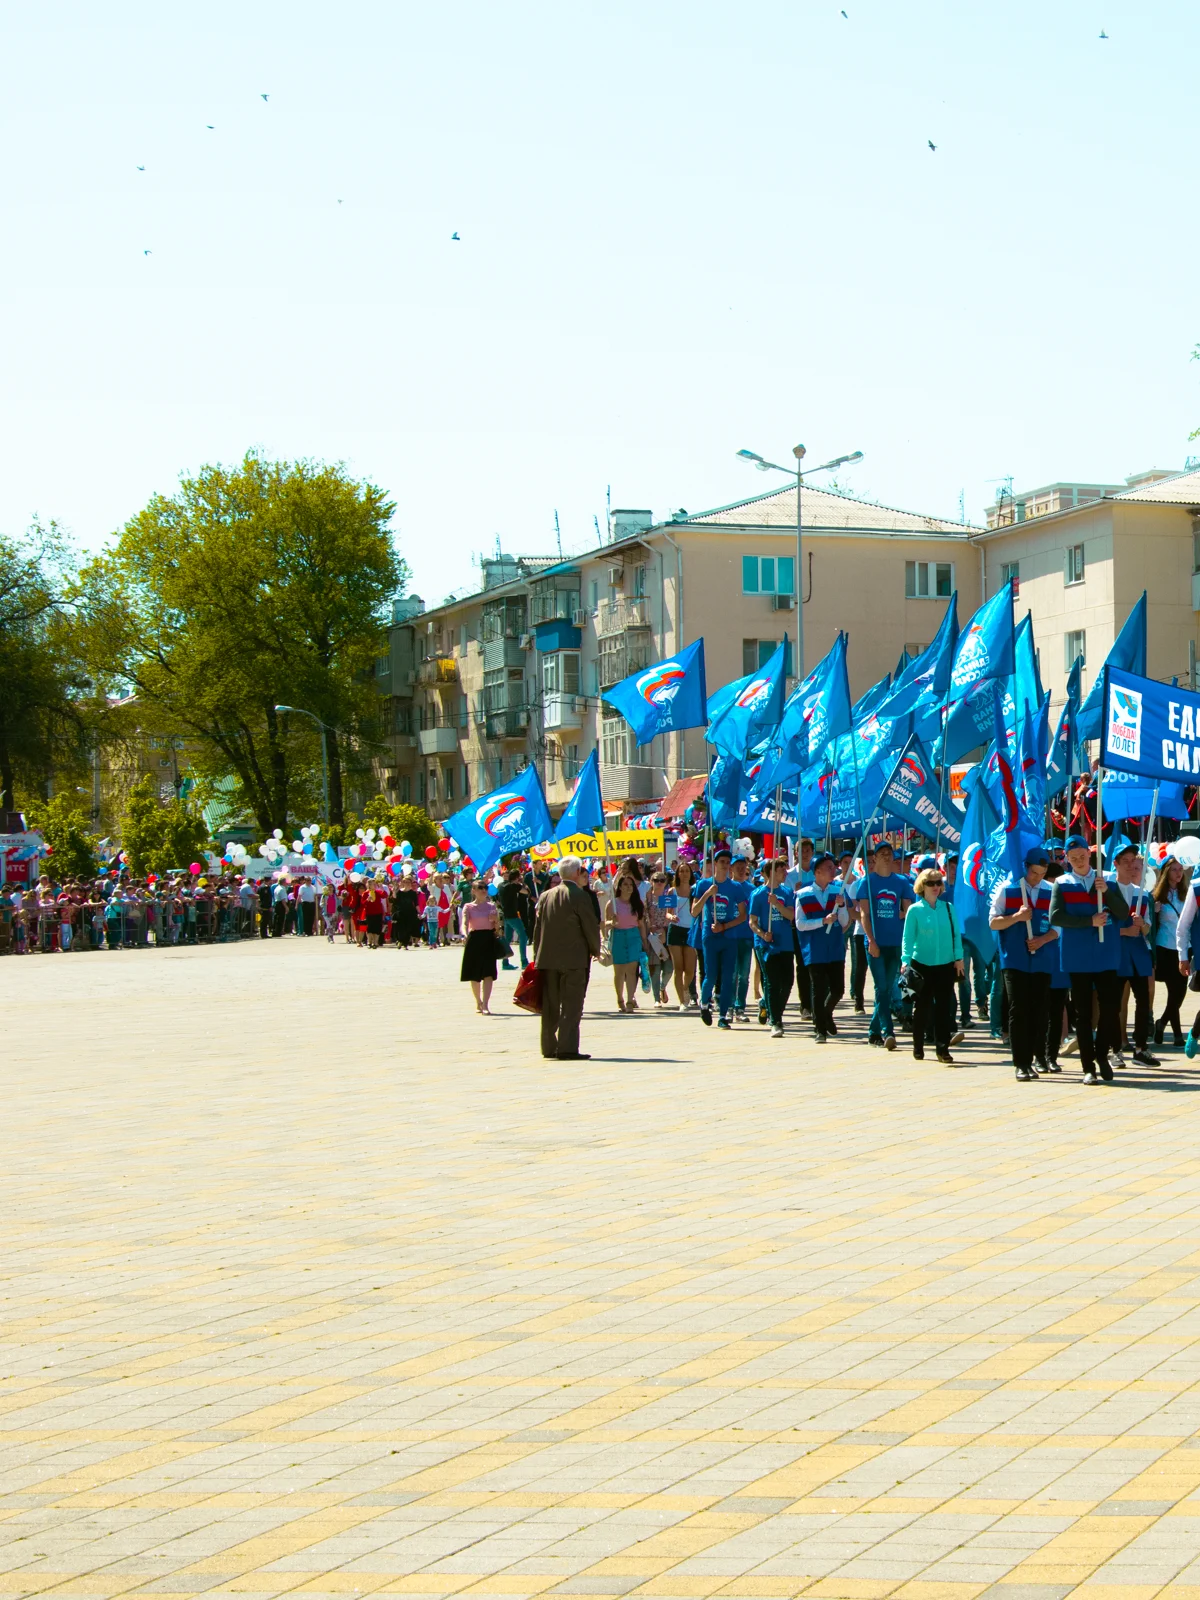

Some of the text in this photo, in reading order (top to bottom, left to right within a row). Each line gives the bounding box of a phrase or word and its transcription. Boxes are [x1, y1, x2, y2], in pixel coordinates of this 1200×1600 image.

[1112, 723, 1136, 740] ПОБЕДА!
[1112, 735, 1136, 754] 70 ЛЕТ
[887, 790, 910, 806] ОССИЯ
[567, 838, 658, 852] ТОС Анапы
